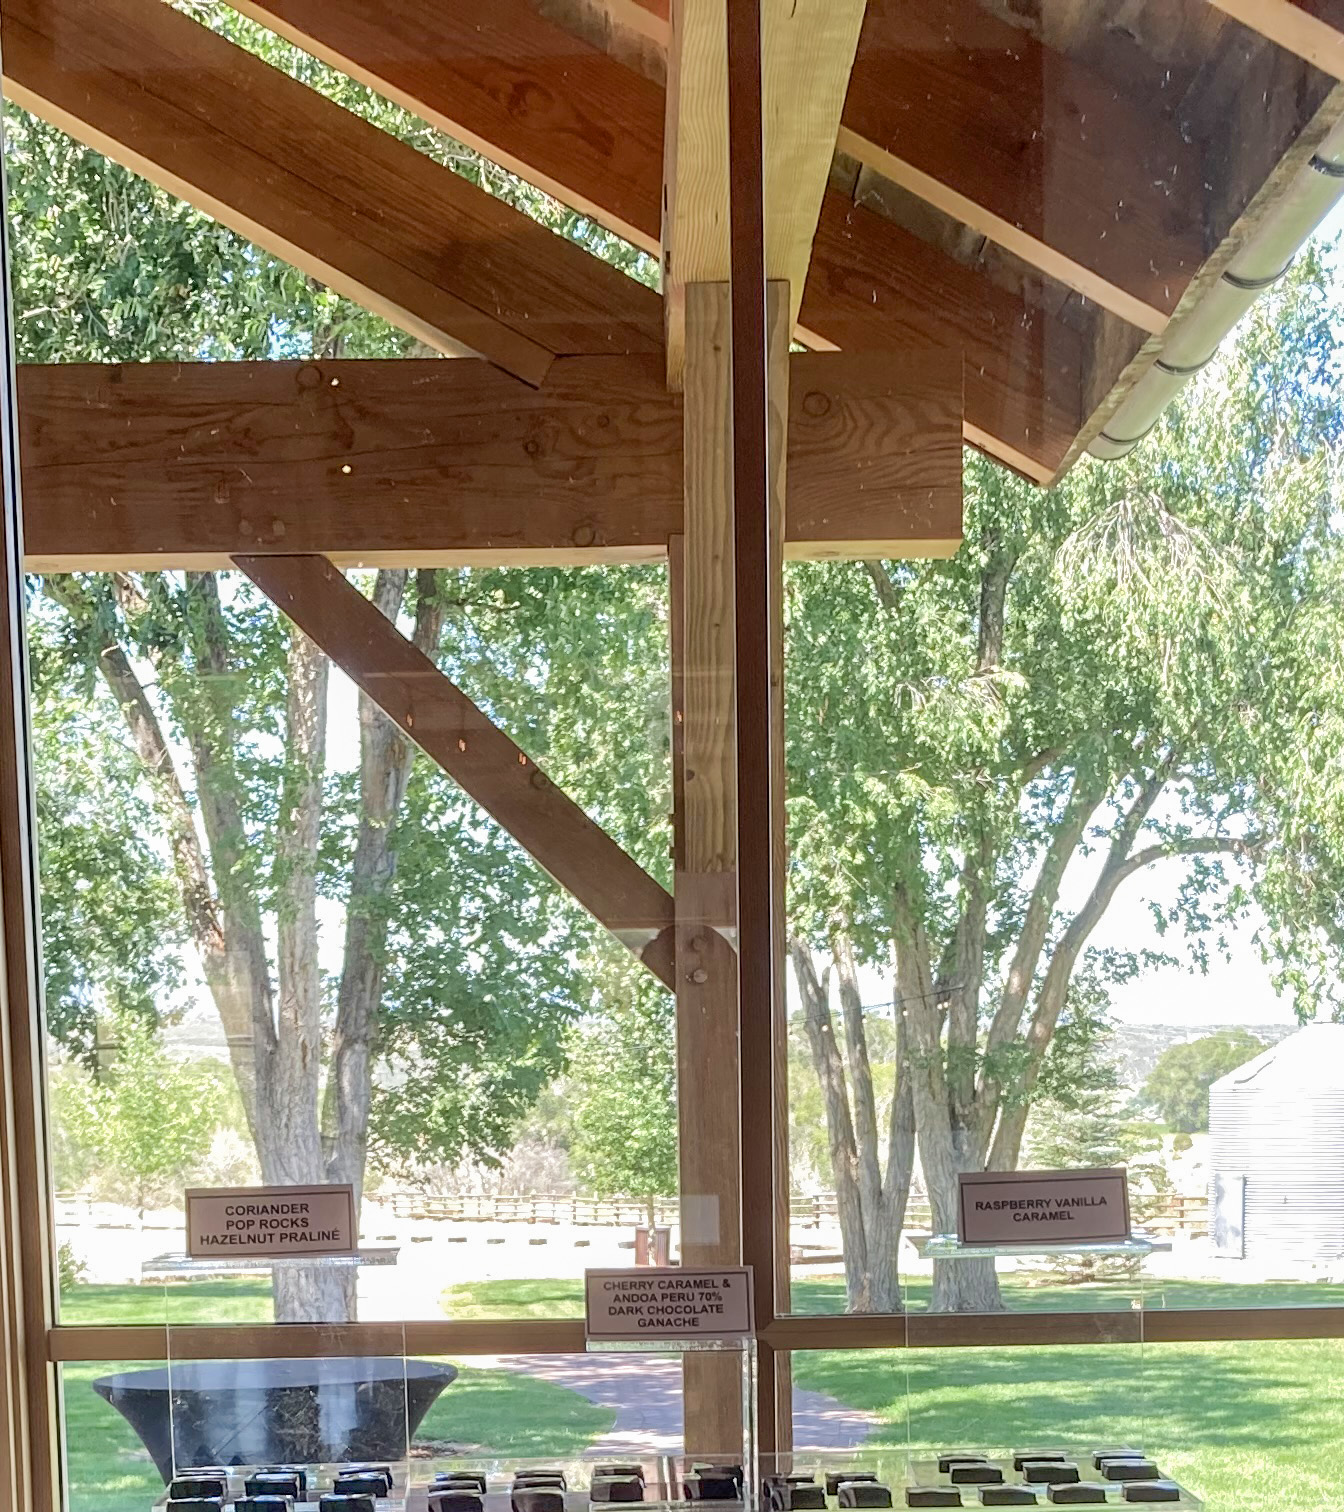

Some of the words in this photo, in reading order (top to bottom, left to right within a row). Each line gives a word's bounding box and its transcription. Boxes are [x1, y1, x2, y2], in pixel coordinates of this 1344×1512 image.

[975, 1199, 1052, 1210] RASPBERRY
[1055, 1196, 1107, 1207] VANILLA
[225, 1203, 310, 1216] CORIANDER
[1013, 1211, 1074, 1222] CARAMEL
[226, 1219, 255, 1230] POP
[259, 1217, 309, 1229] ROCKS
[200, 1233, 276, 1245] HAZELNUT
[279, 1227, 340, 1243] PRALINÉ
[603, 1281, 654, 1291] CHERRY
[658, 1280, 718, 1290] CARAMEL
[722, 1279, 731, 1288] &
[613, 1293, 658, 1303] ANDOA
[661, 1292, 695, 1302] PERU
[699, 1291, 722, 1301] 70%
[608, 1305, 643, 1316] DARK
[647, 1304, 724, 1315] CHOCOLATE
[638, 1317, 699, 1328] GANACHE
